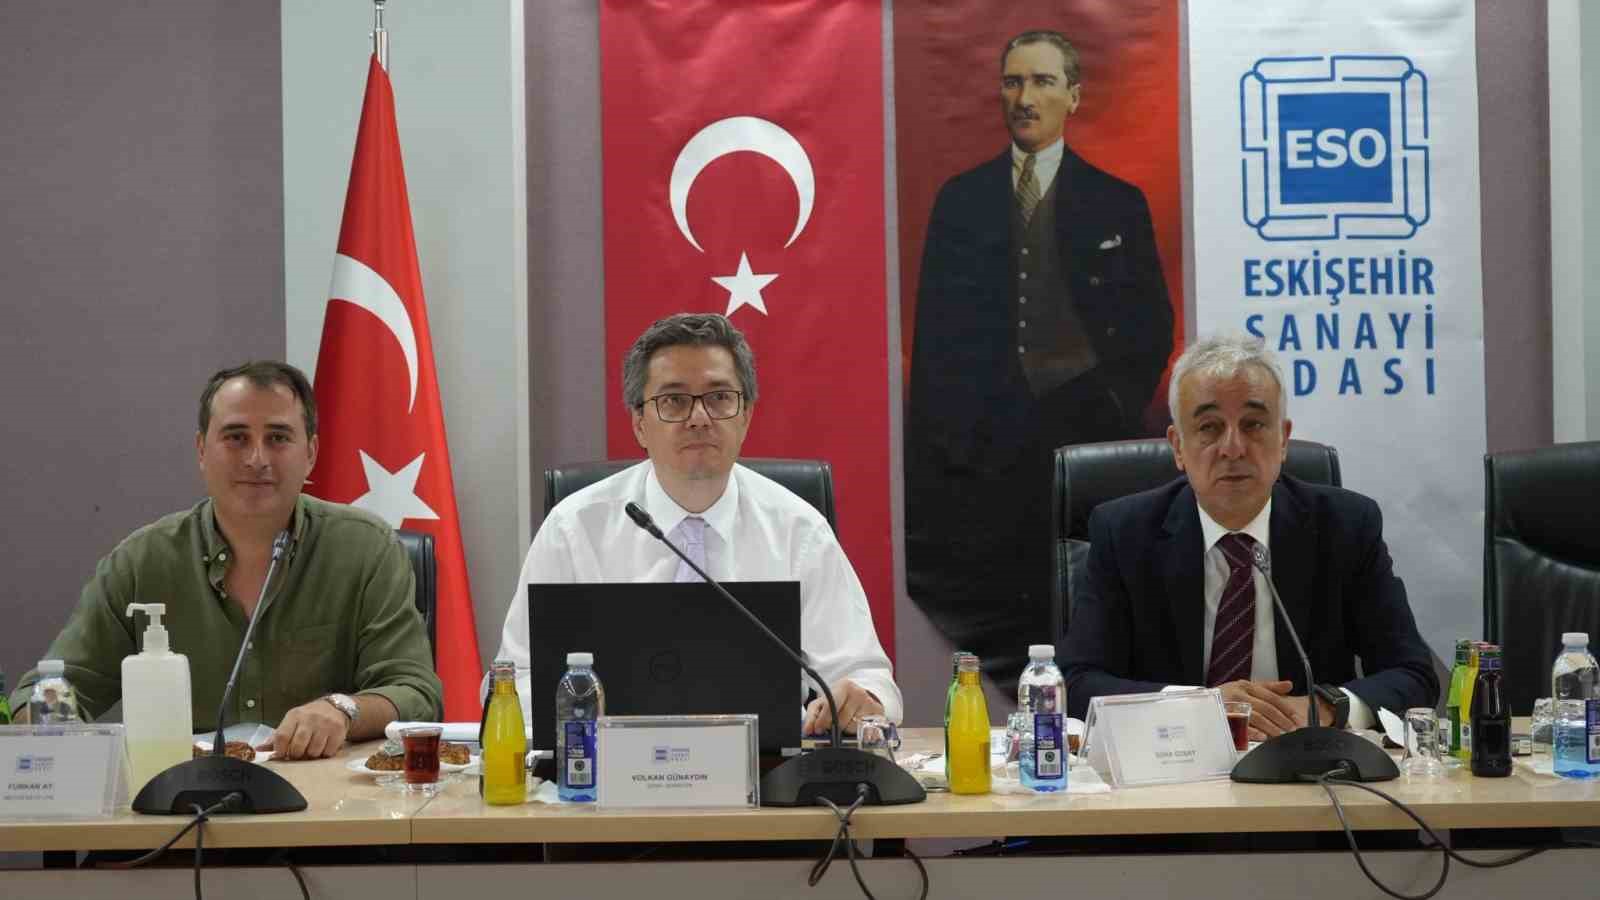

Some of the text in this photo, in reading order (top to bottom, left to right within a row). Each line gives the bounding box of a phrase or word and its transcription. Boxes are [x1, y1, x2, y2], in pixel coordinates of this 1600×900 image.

[1286, 128, 1387, 170] ESO
[1244, 250, 1435, 306] ESKİŞEHİR
[1245, 303, 1435, 351] SANAYİ
[1293, 358, 1435, 396] DASI
[631, 773, 665, 782] VOLKAN
